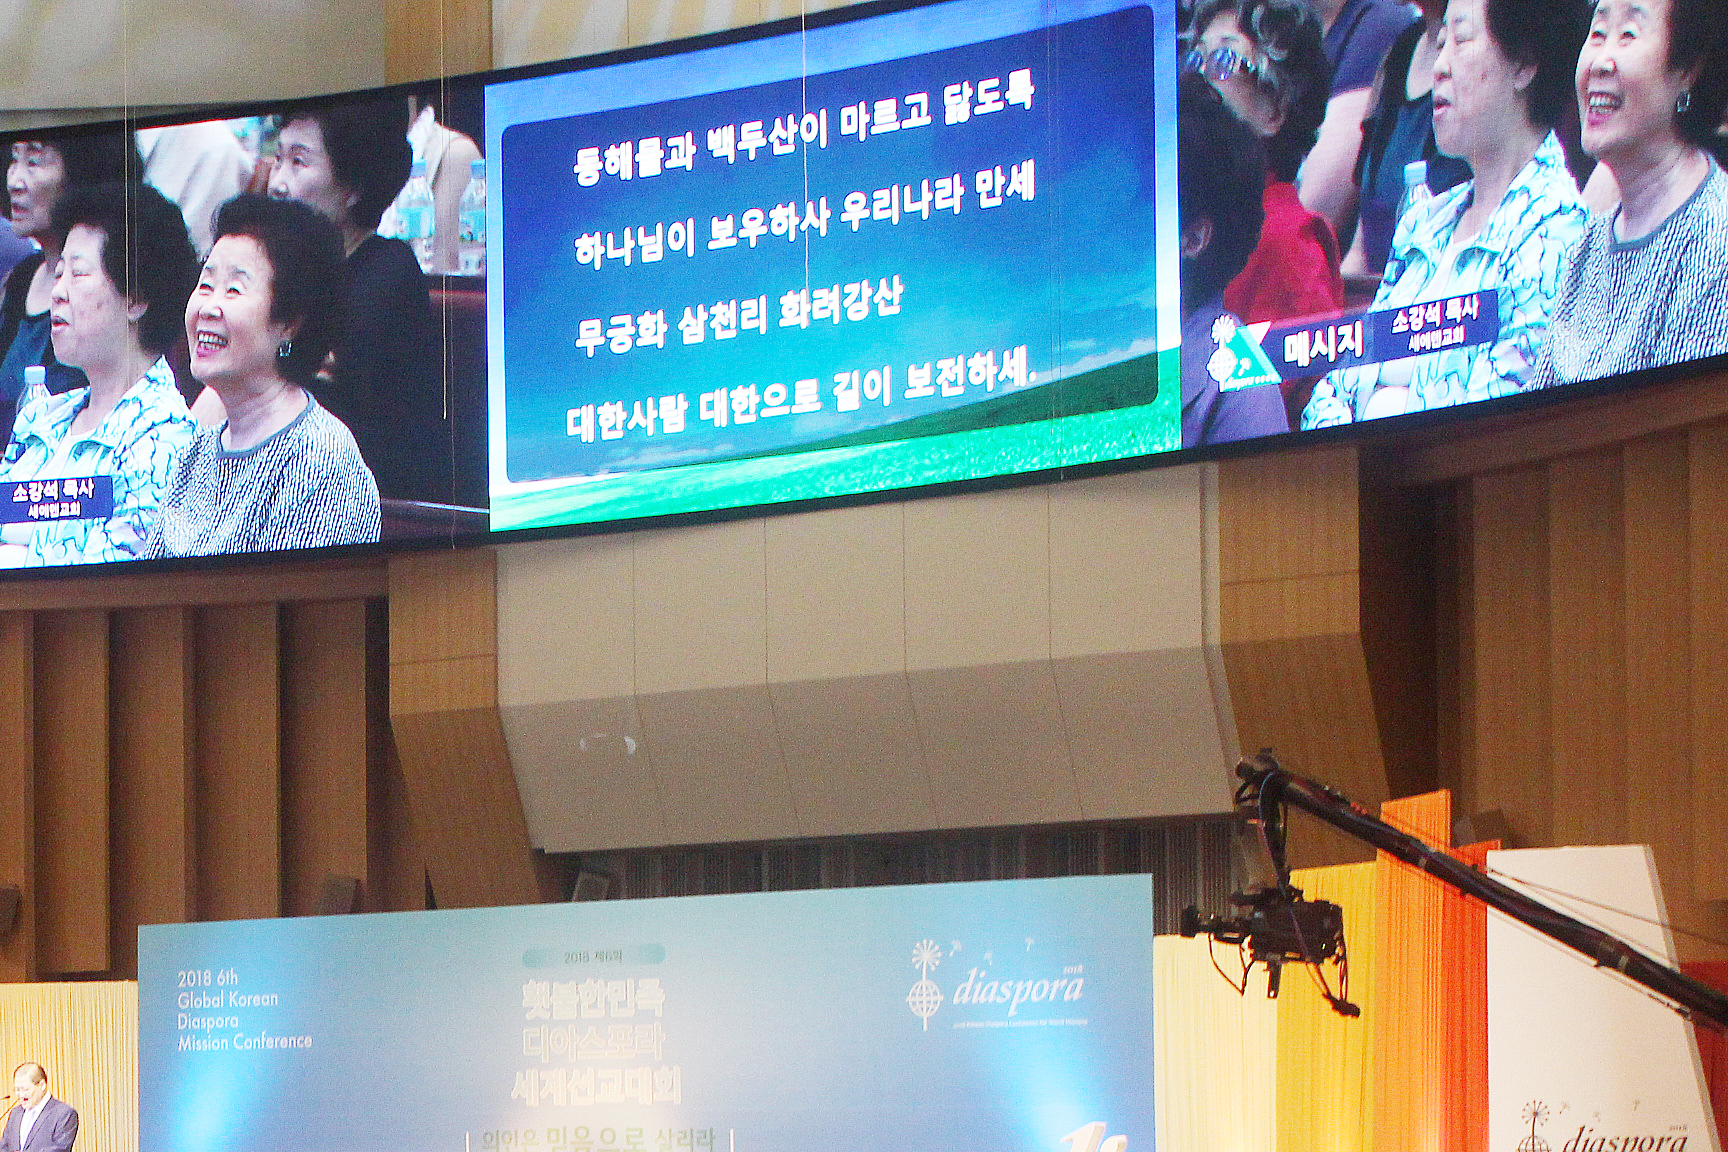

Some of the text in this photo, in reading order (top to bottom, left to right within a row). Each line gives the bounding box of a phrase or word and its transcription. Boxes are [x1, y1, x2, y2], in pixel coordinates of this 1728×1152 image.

[573, 67, 1036, 187] 동해물과 백두산이 마르고 닳도록
[574, 158, 1036, 271] 하나님이 보우하사 우리나라 만세
[575, 275, 904, 357] 무궁화 삼천리 화려강산
[1284, 320, 1364, 367] 메시지
[566, 344, 1041, 443] 대한사람 대한으로 길이 보전하세.
[177, 967, 238, 988] 2018 6th
[177, 989, 278, 1009] Global Korean
[953, 967, 1085, 1017] diaspora
[177, 1013, 239, 1033] Diaspora
[177, 1030, 314, 1052] Mission Conference
[522, 1022, 667, 1063] 디아스포라
[510, 1065, 683, 1107] 세계선교대회
